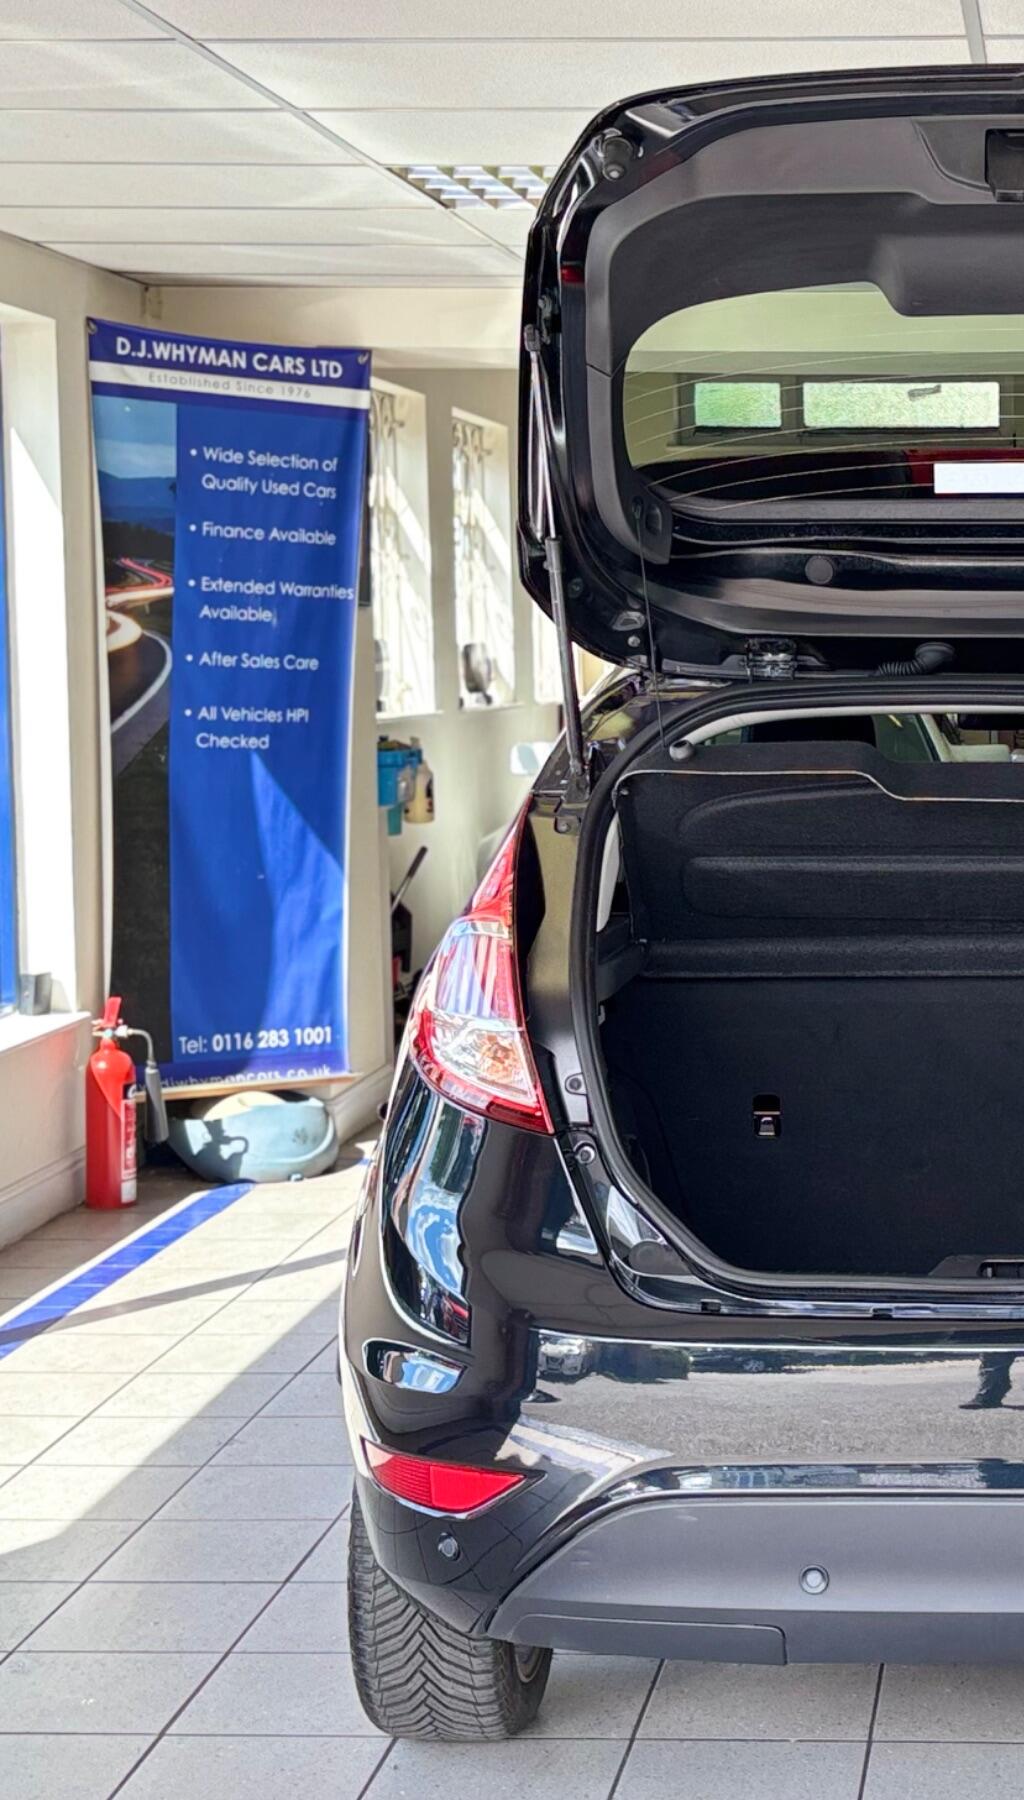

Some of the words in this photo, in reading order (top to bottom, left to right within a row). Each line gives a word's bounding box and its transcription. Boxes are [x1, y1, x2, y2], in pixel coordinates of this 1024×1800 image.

[116, 337, 247, 369] D.J.WHYMAN
[252, 354, 305, 376] CARS
[311, 360, 343, 379] LTD
[148, 371, 231, 391] Established
[235, 381, 274, 395] Since
[281, 385, 311, 399] 1976
[203, 446, 244, 464] Wide
[247, 452, 319, 471] Selection
[322, 457, 338, 471] of
[201, 474, 258, 495] Quality
[262, 480, 300, 497] Used
[303, 483, 337, 499] Cars
[202, 521, 265, 539] Finance
[270, 528, 337, 545] Available
[201, 576, 275, 595] Extended
[280, 582, 355, 600] Warranties
[199, 605, 273, 622] Available
[198, 651, 237, 668] After
[241, 653, 280, 669] Sales
[283, 655, 319, 670] Care
[197, 706, 217, 721] All
[220, 706, 283, 722] Vehicles
[286, 707, 309, 722] HPI
[196, 732, 269, 749] Checked
[178, 1035, 208, 1054] Tel:
[212, 1032, 254, 1052] 0116
[257, 1028, 289, 1049] 283
[295, 1026, 332, 1046] 1001
